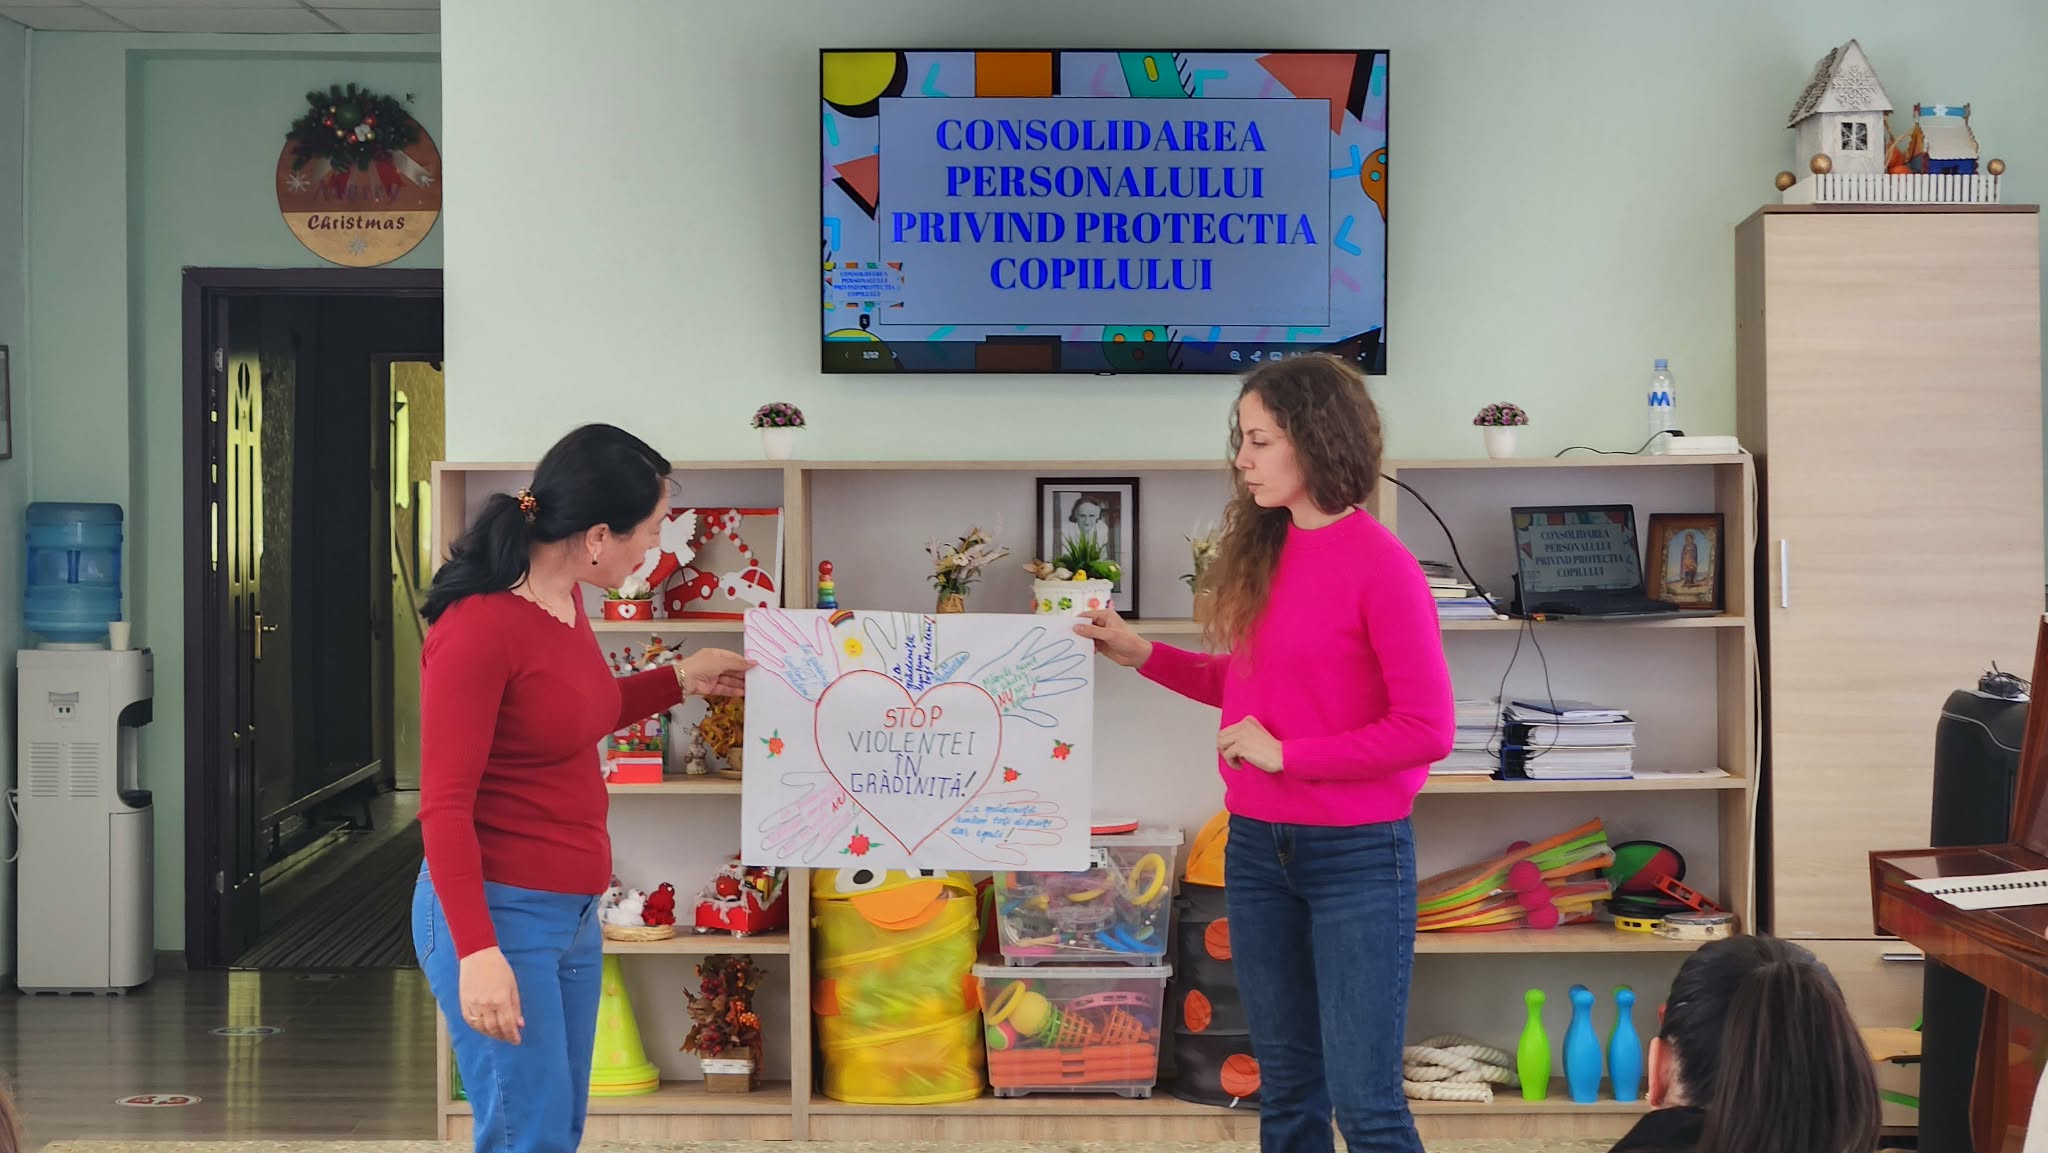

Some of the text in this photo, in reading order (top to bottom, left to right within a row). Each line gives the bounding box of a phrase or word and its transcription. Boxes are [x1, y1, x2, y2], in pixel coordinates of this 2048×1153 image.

[936, 119, 1266, 153] CONSOLIDAREA
[946, 165, 1264, 199] PERSONALULUI
[307, 214, 406, 231] Christmas
[891, 211, 1318, 246] PRIVIND PROTECTIA
[989, 257, 1213, 292] COPILULUI
[1540, 529, 1610, 540] CONSOLIDAREA
[1544, 542, 1611, 553] PERSONALULUI
[1535, 555, 1572, 566] PRIVIND
[883, 705, 943, 728] STOP
[896, 753, 922, 777] ÎN
